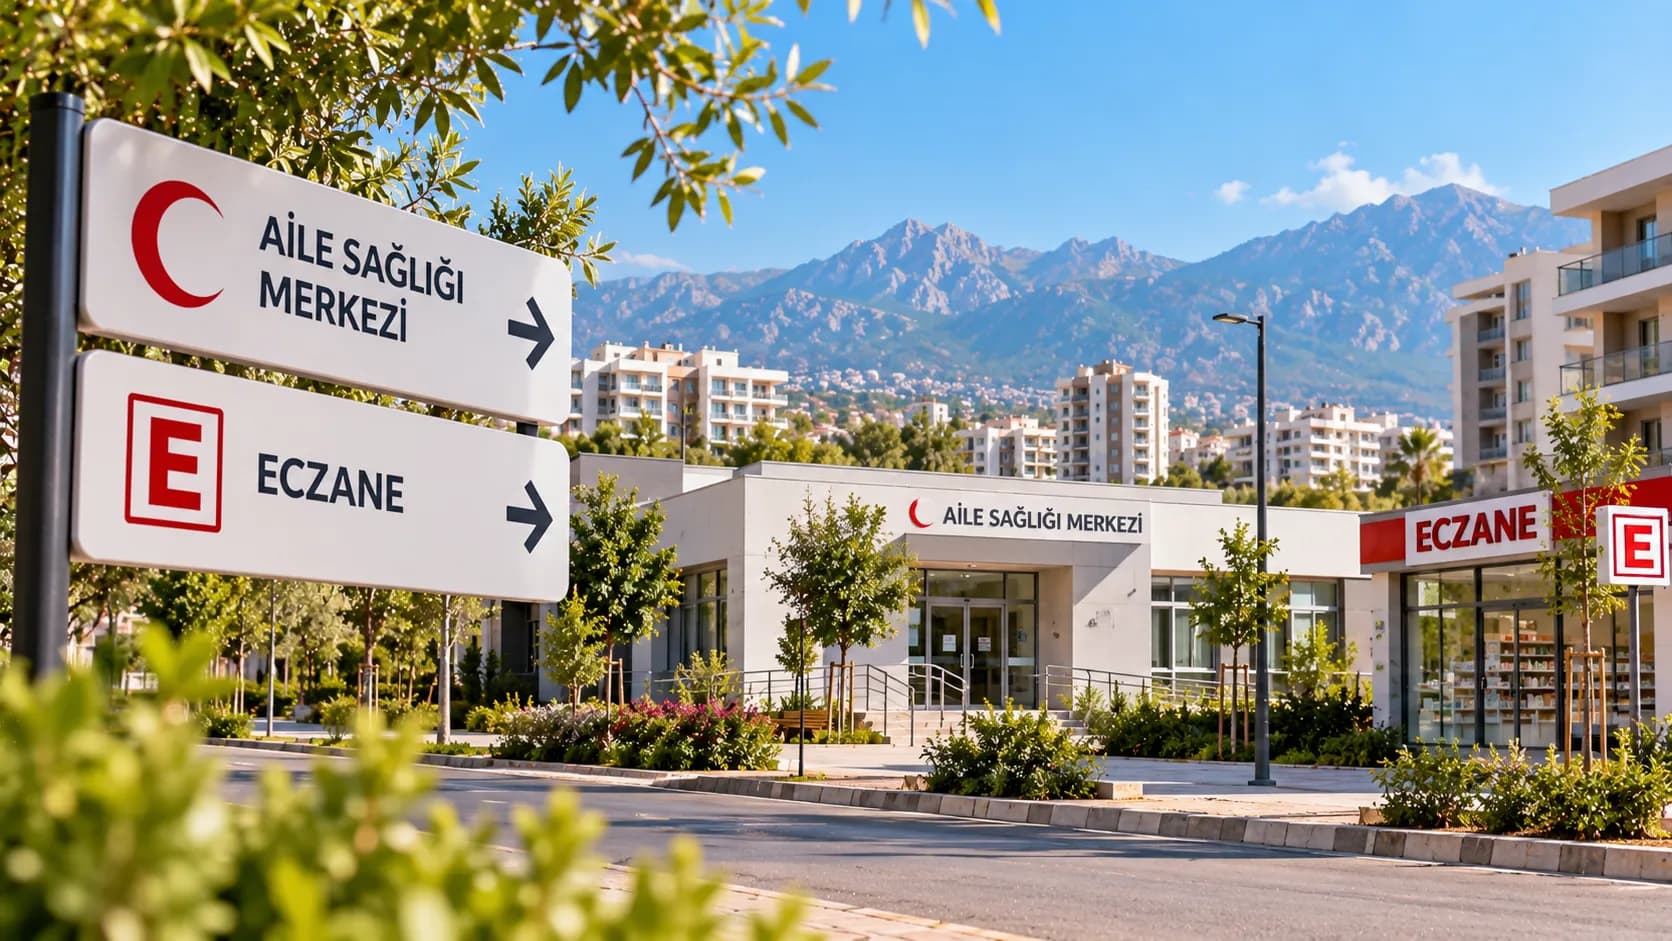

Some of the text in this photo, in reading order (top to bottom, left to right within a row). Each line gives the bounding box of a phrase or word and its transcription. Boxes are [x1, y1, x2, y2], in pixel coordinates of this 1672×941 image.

[259, 211, 465, 305] AİLE SAĞLIĞI
[259, 270, 408, 343] MERKEZİ
[148, 416, 203, 512] E
[257, 452, 405, 514] ECZANE
[942, 502, 1143, 534] AİLE SAĞLIĞI MERKEZİ
[1415, 504, 1538, 554] ECZANE
[1623, 524, 1655, 569] E
